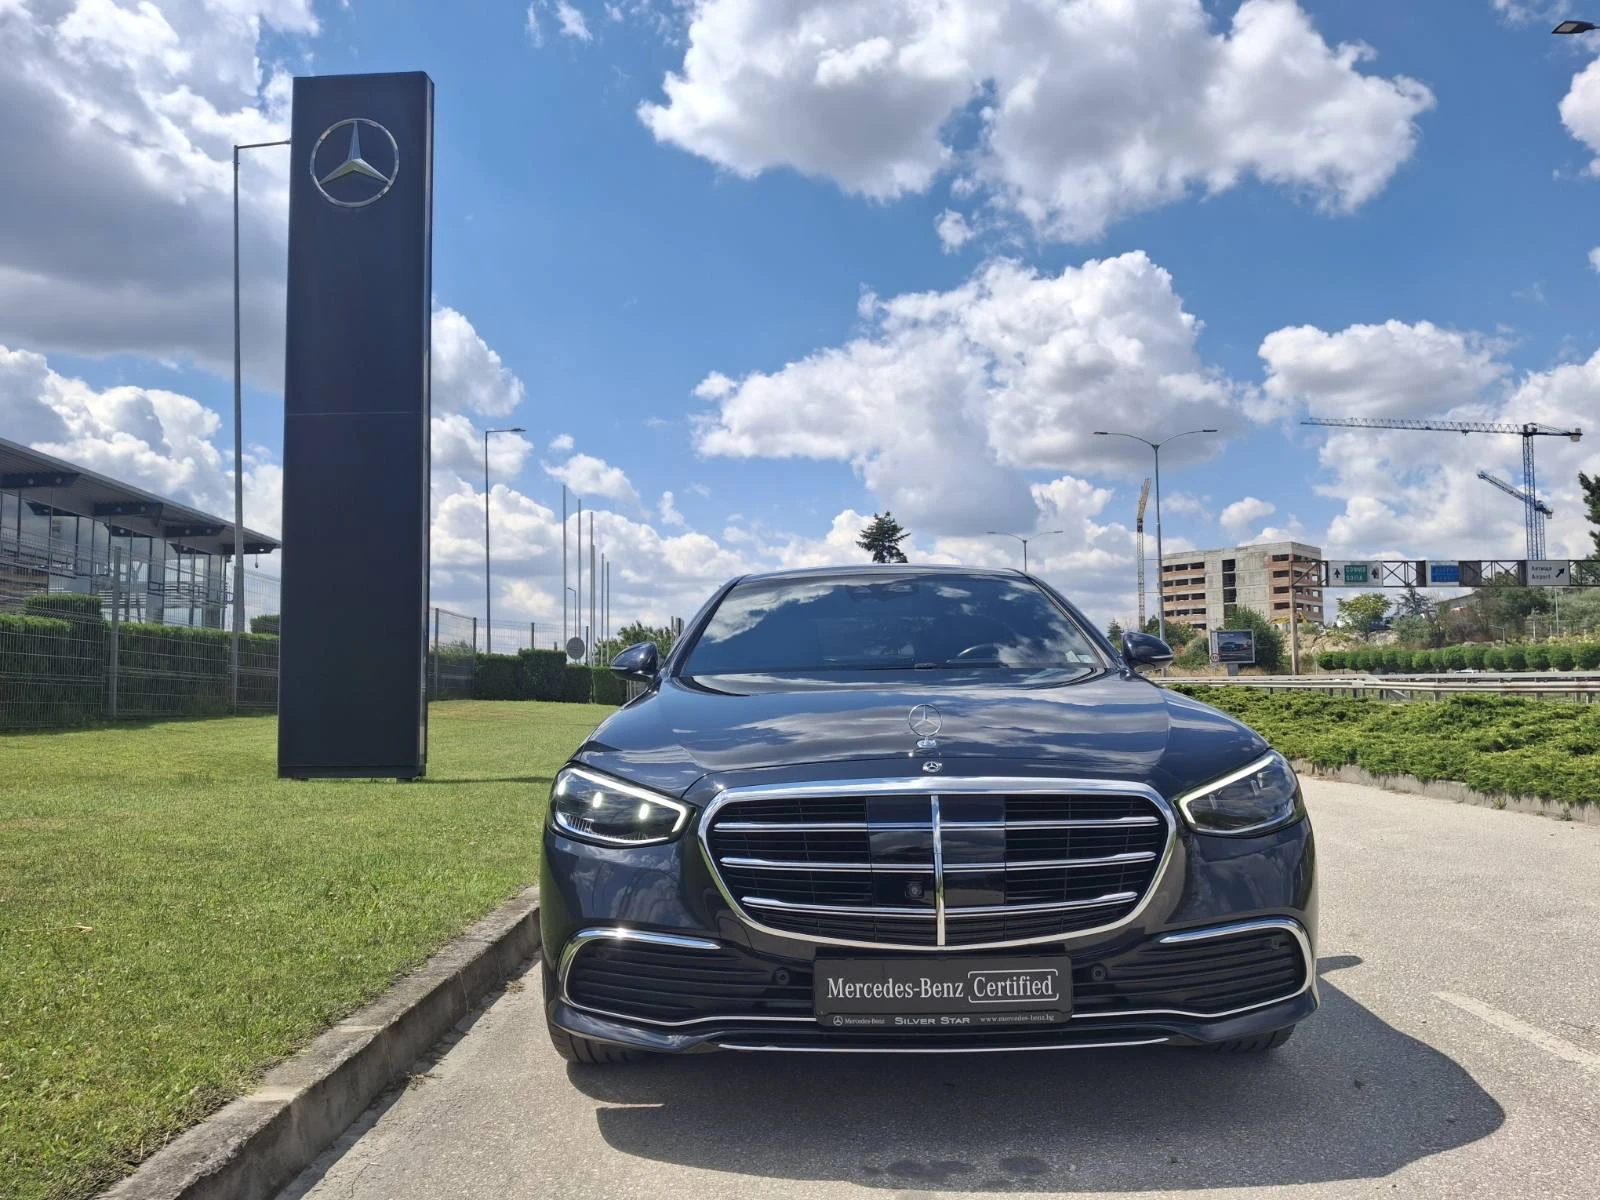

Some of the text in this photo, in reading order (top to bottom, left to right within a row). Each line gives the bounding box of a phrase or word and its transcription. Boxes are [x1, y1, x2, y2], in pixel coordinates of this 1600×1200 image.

[827, 975, 1053, 998] Mercedes-Benz Certified
[894, 1016, 970, 1025] SILVER STAR
